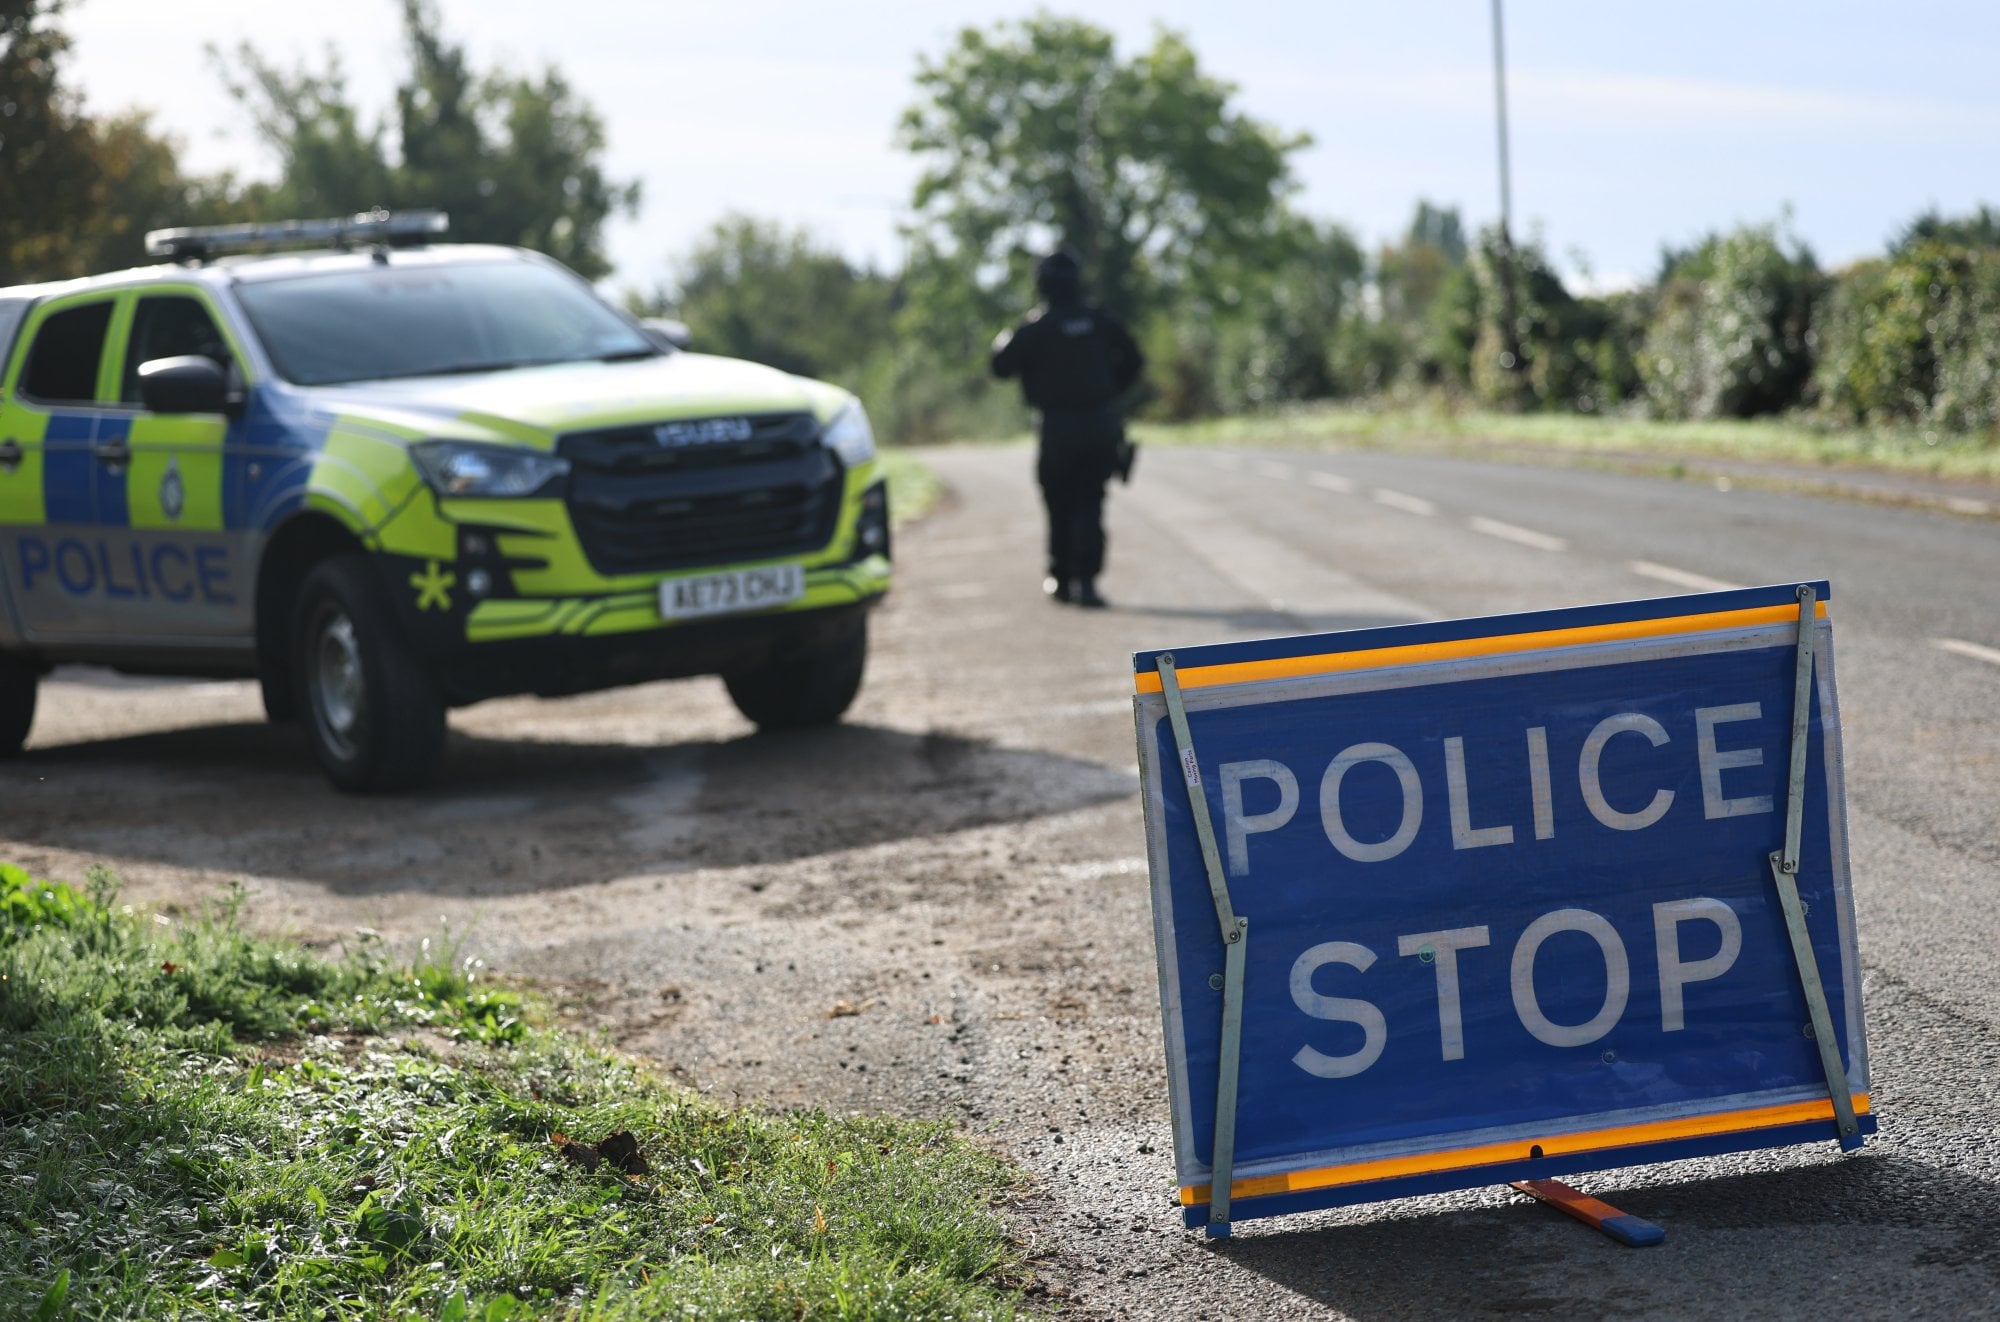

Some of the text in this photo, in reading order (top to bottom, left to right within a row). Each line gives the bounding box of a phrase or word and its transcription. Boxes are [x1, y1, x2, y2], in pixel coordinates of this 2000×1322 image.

[655, 417, 751, 447] ISUZU
[17, 536, 237, 606] POLICE
[672, 575, 739, 609] AE73
[1219, 702, 1774, 877] POLICE
[1290, 897, 1742, 1078] STOP
